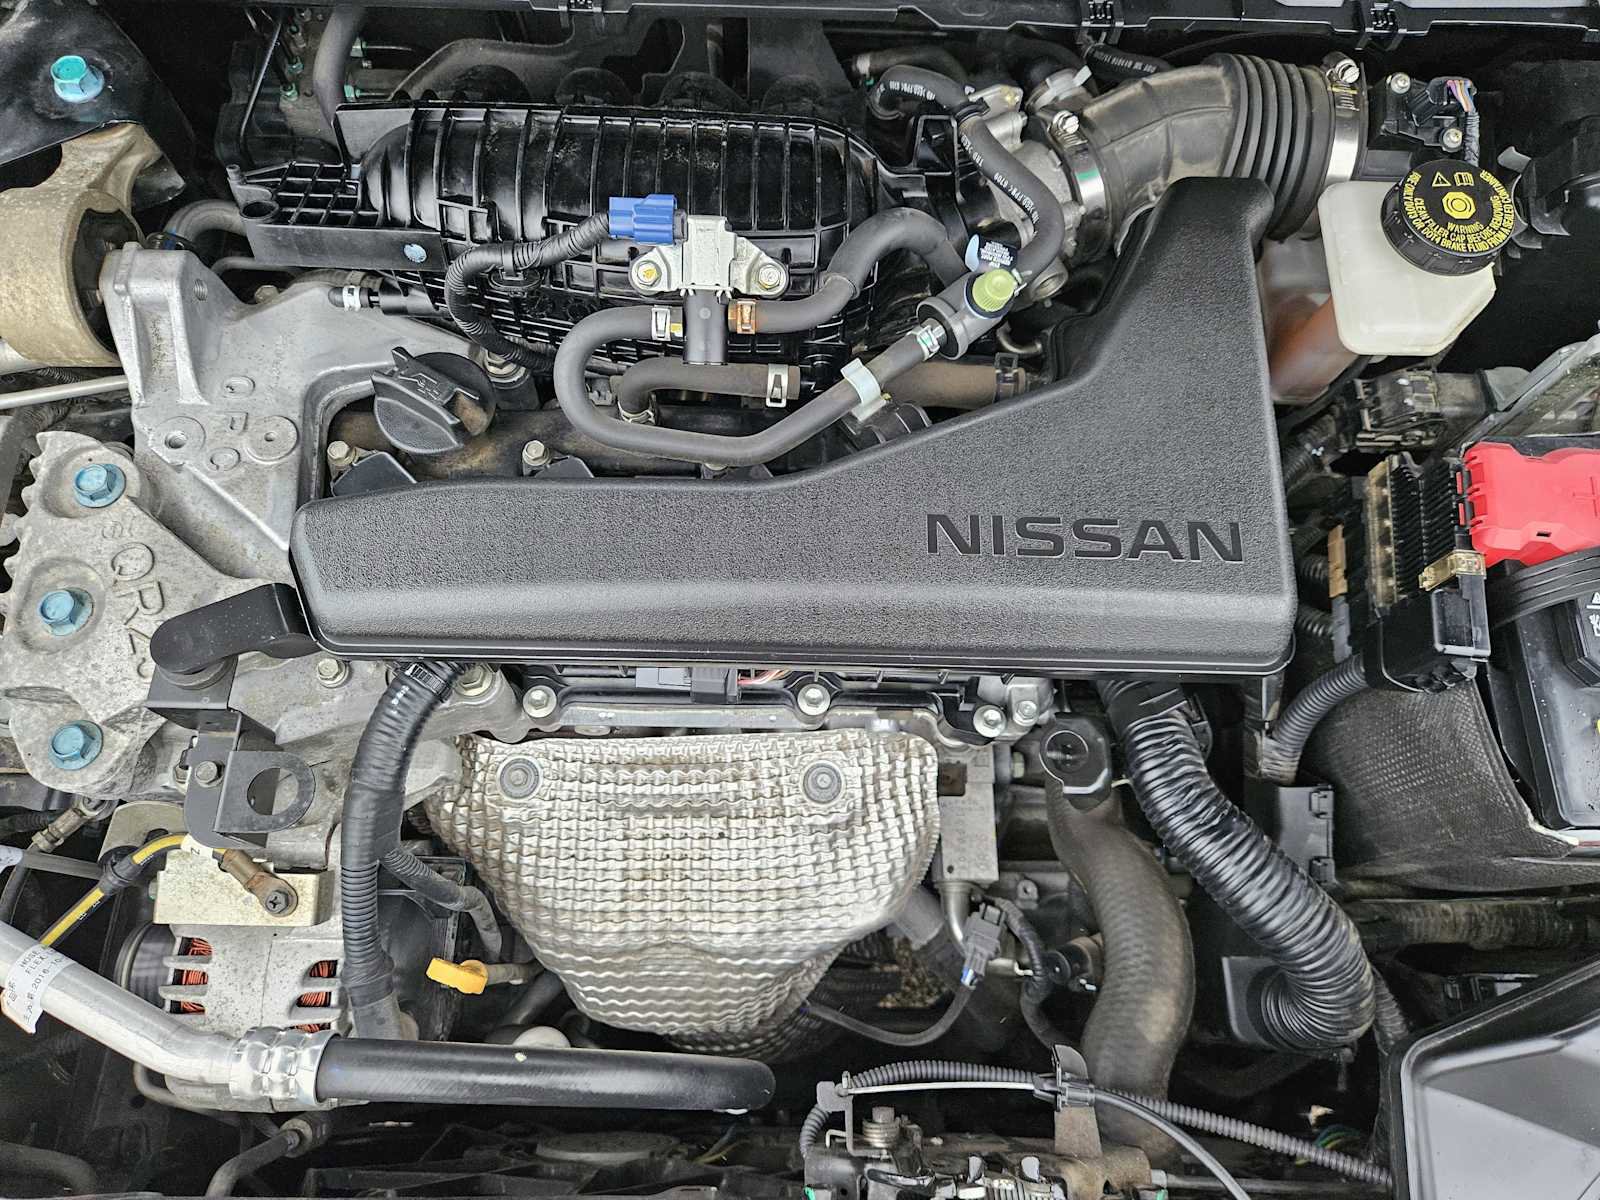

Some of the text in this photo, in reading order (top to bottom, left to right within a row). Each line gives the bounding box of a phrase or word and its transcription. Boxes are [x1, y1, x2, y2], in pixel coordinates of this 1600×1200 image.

[1412, 218, 1425, 230] OR
[1440, 238, 1467, 252] BRAKE
[1467, 241, 1489, 252] FLUID
[1486, 231, 1507, 247] FROM
[1414, 196, 1503, 243] CLEAN FILLER CAP BEFORE REMOVING
[1447, 222, 1484, 234] WARNING
[926, 513, 1244, 563] NISSAN
